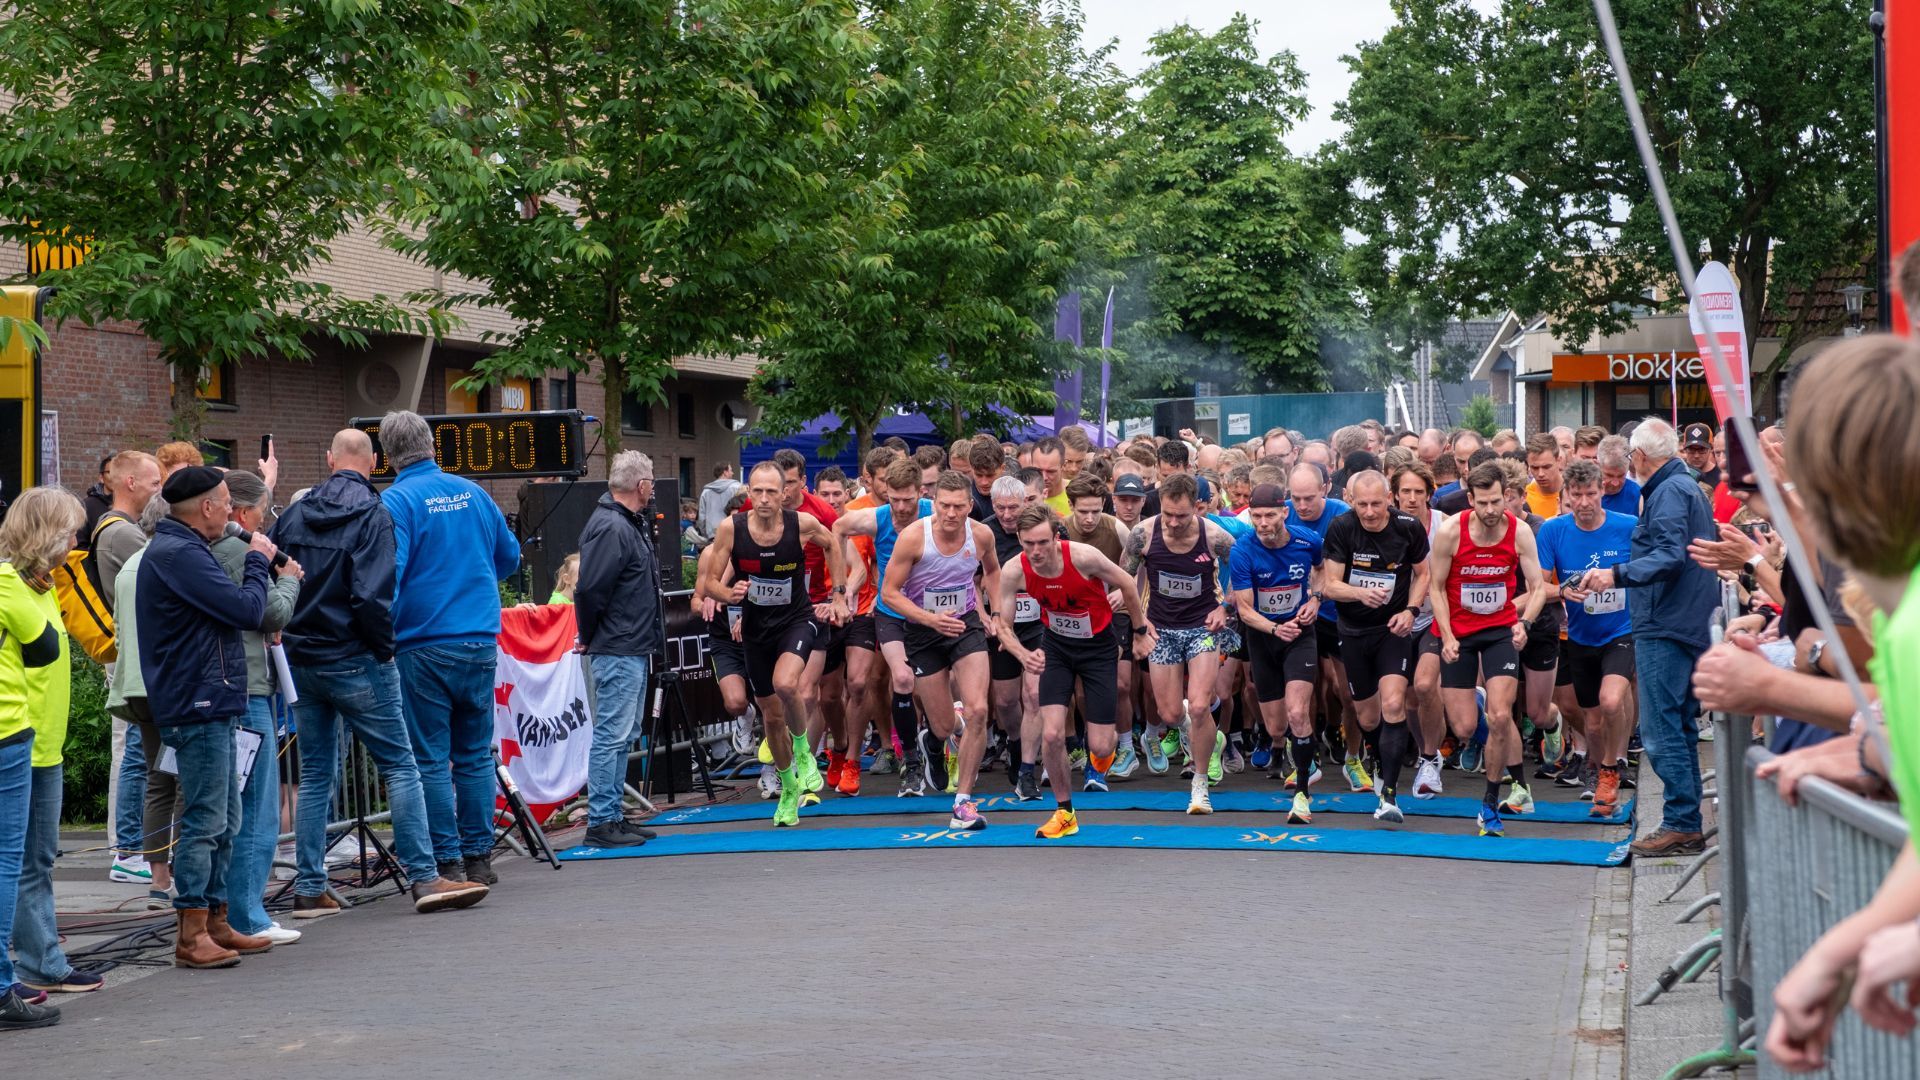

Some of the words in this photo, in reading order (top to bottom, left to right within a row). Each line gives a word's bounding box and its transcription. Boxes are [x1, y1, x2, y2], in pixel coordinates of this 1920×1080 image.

[425, 492, 471, 505] SPORTLEAD
[429, 501, 468, 514] FACILITIES
[1168, 580, 1192, 590] 1215
[757, 586, 783, 596] 1192
[935, 595, 957, 606] 1211
[1269, 594, 1291, 604] 699
[1471, 592, 1497, 603] 1061
[1594, 592, 1616, 603] 1121
[1056, 618, 1080, 629] 528
